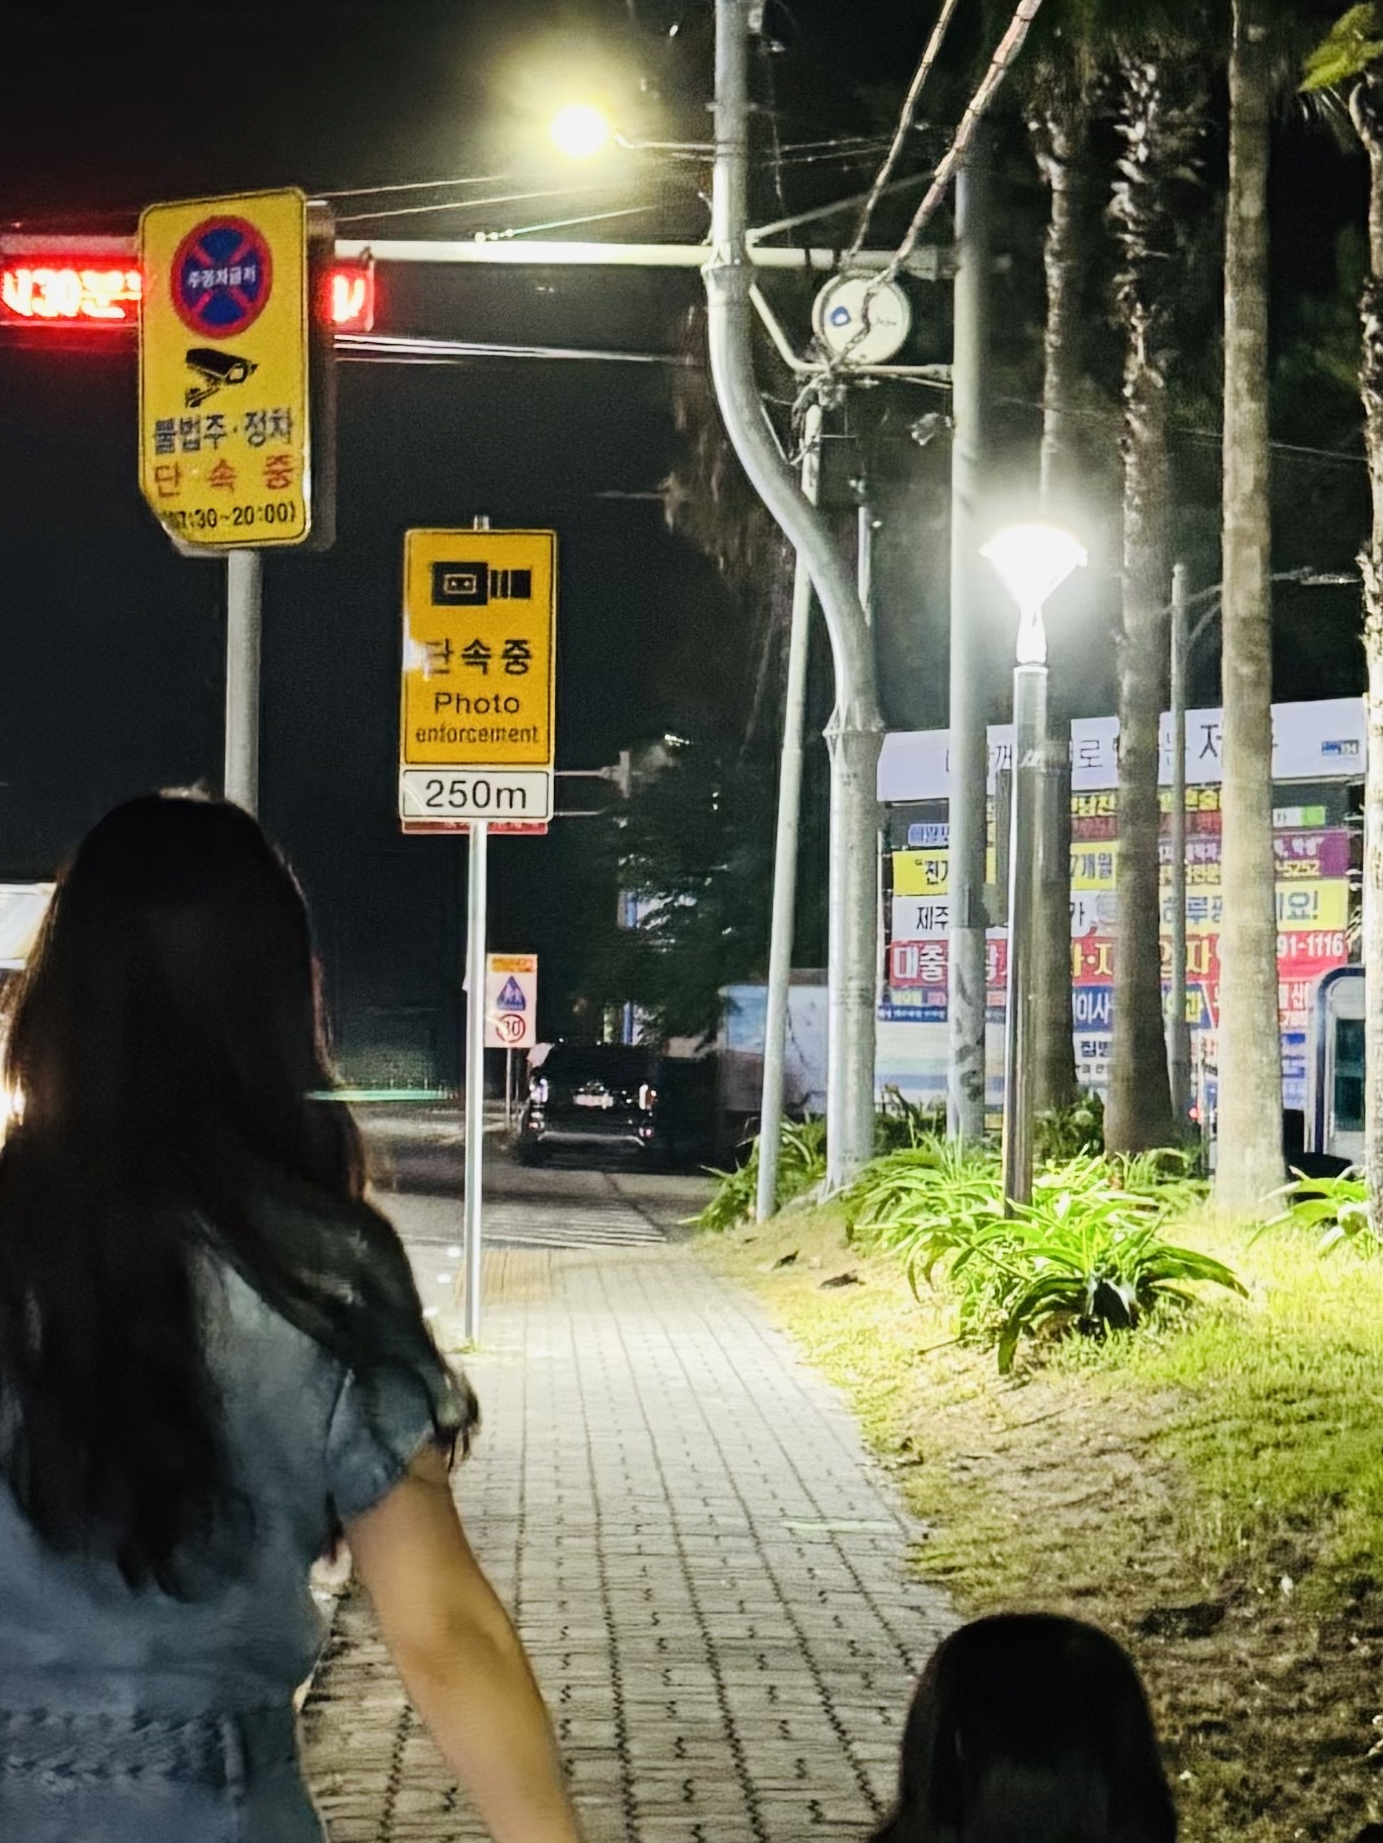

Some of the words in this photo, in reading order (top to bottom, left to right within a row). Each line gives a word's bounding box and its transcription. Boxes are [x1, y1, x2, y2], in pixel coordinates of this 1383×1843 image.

[162, 501, 296, 529] 7:30~20:00)
[434, 692, 520, 715] Photo
[416, 724, 539, 744] enforcement
[425, 779, 527, 809] 250m
